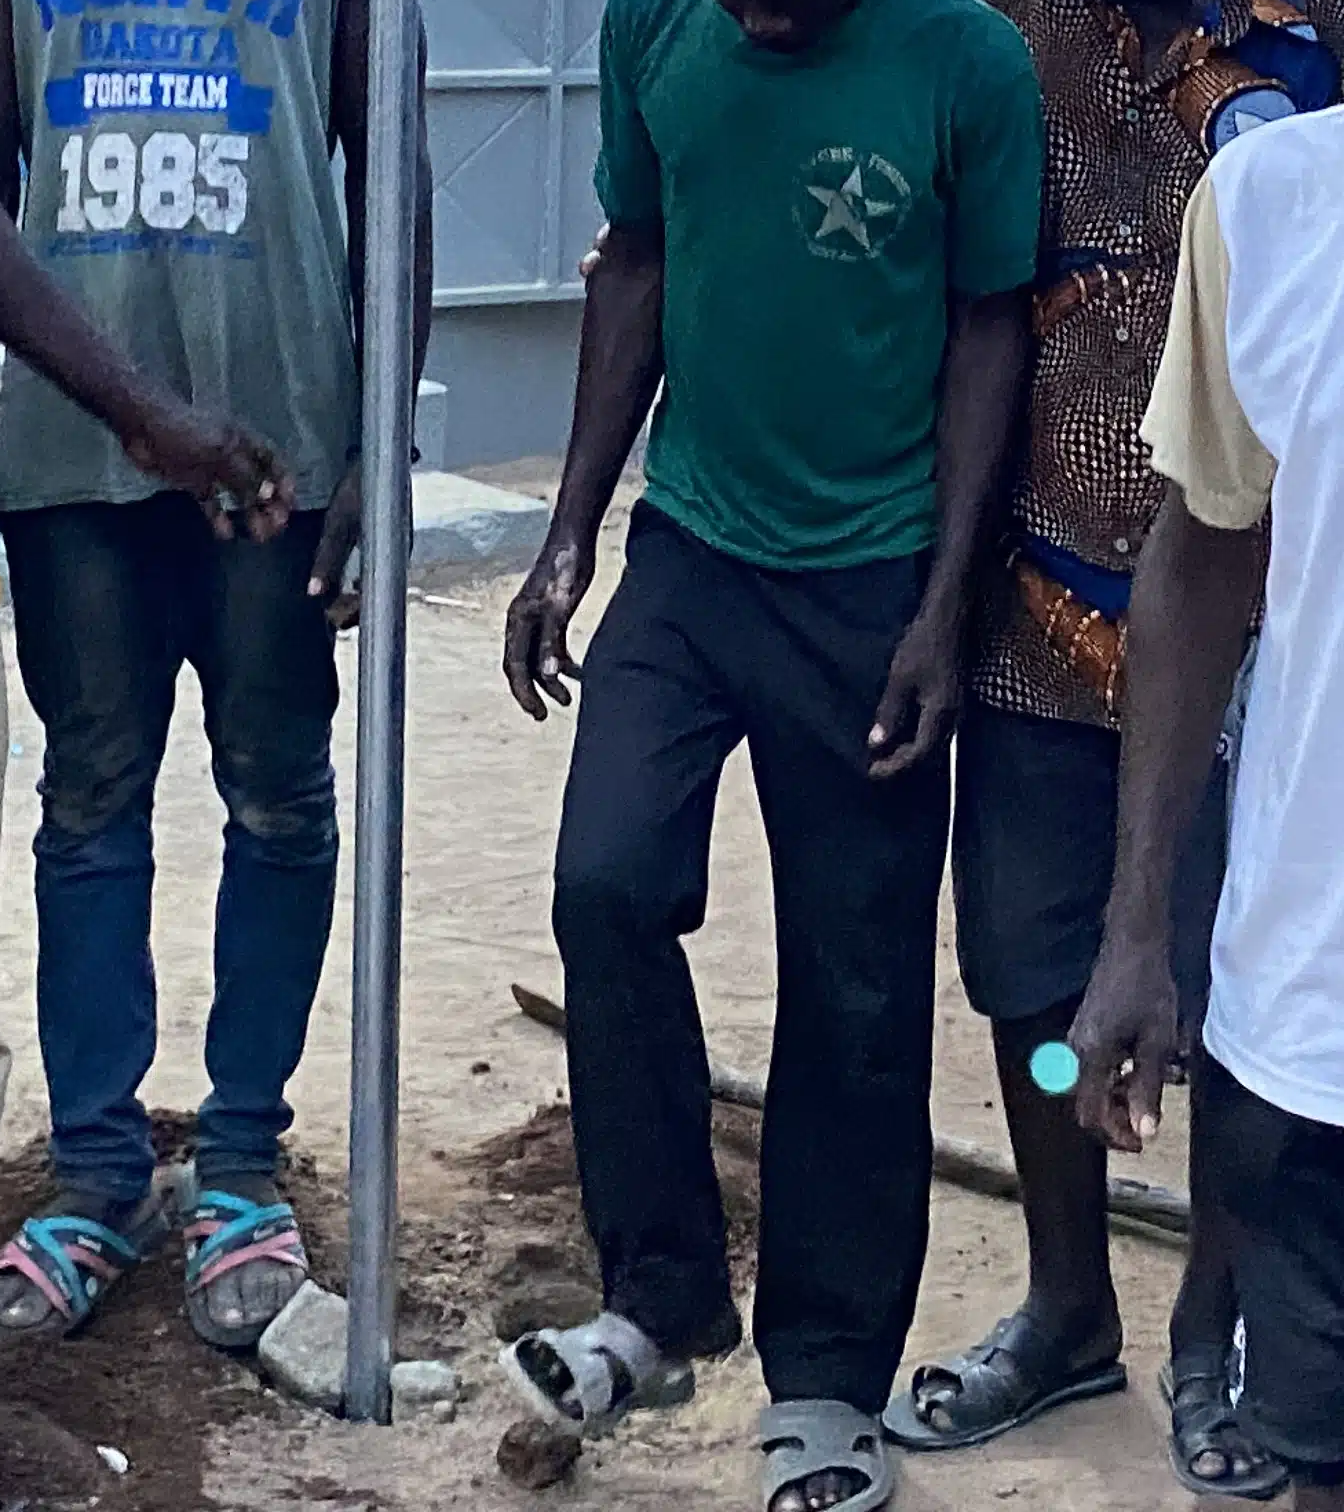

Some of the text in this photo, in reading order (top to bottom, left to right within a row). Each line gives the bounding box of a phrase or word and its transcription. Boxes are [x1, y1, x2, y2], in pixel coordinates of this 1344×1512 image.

[83, 72, 228, 109] FORCE TEAM
[56, 130, 249, 235] 1985
